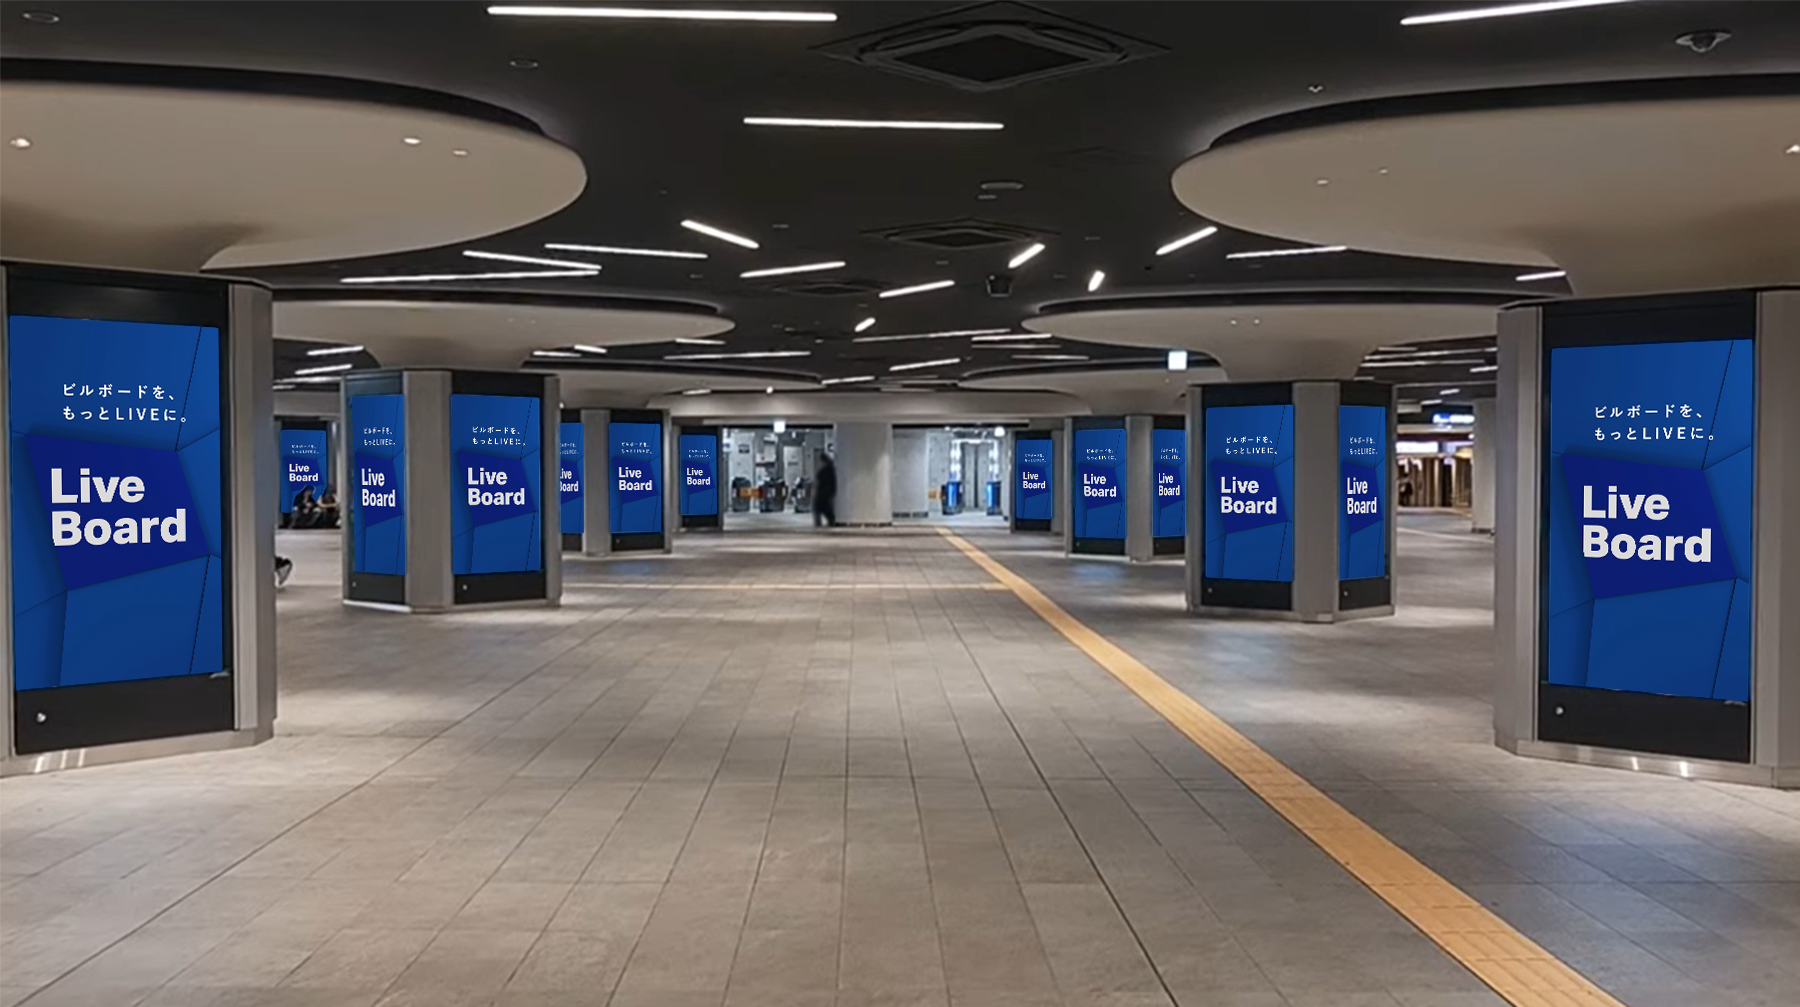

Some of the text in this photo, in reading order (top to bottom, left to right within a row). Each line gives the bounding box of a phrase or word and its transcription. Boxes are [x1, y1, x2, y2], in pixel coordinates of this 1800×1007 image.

[63, 382, 174, 401] ビルボードを、
[62, 405, 187, 423] もっとLIVEに。
[1595, 403, 1702, 419] ビルボードを、
[1226, 435, 1273, 444] ビルボードを、
[1594, 426, 1714, 441] もっとLIVEに。
[289, 464, 309, 472] Live
[560, 468, 572, 479] ive
[619, 467, 641, 478] Live
[687, 468, 703, 476] Live
[289, 473, 318, 481] Board
[362, 468, 384, 486] Live
[468, 468, 507, 485] Live
[687, 477, 710, 485] Board
[1023, 472, 1038, 480] Live
[1084, 474, 1106, 484] Live
[1159, 473, 1173, 483] Live
[51, 468, 145, 503] Live
[619, 480, 652, 490] Board
[1023, 481, 1045, 489] Board
[1084, 486, 1116, 497] Board
[1159, 485, 1180, 496] Board
[1221, 477, 1259, 493] Live
[1347, 477, 1367, 494] Live
[362, 489, 395, 507] Board
[468, 488, 525, 505] Board
[1584, 486, 1669, 520] Live
[1221, 496, 1276, 514] Board
[1347, 497, 1376, 514] Board
[52, 509, 186, 546] Board
[1583, 525, 1711, 562] Board
